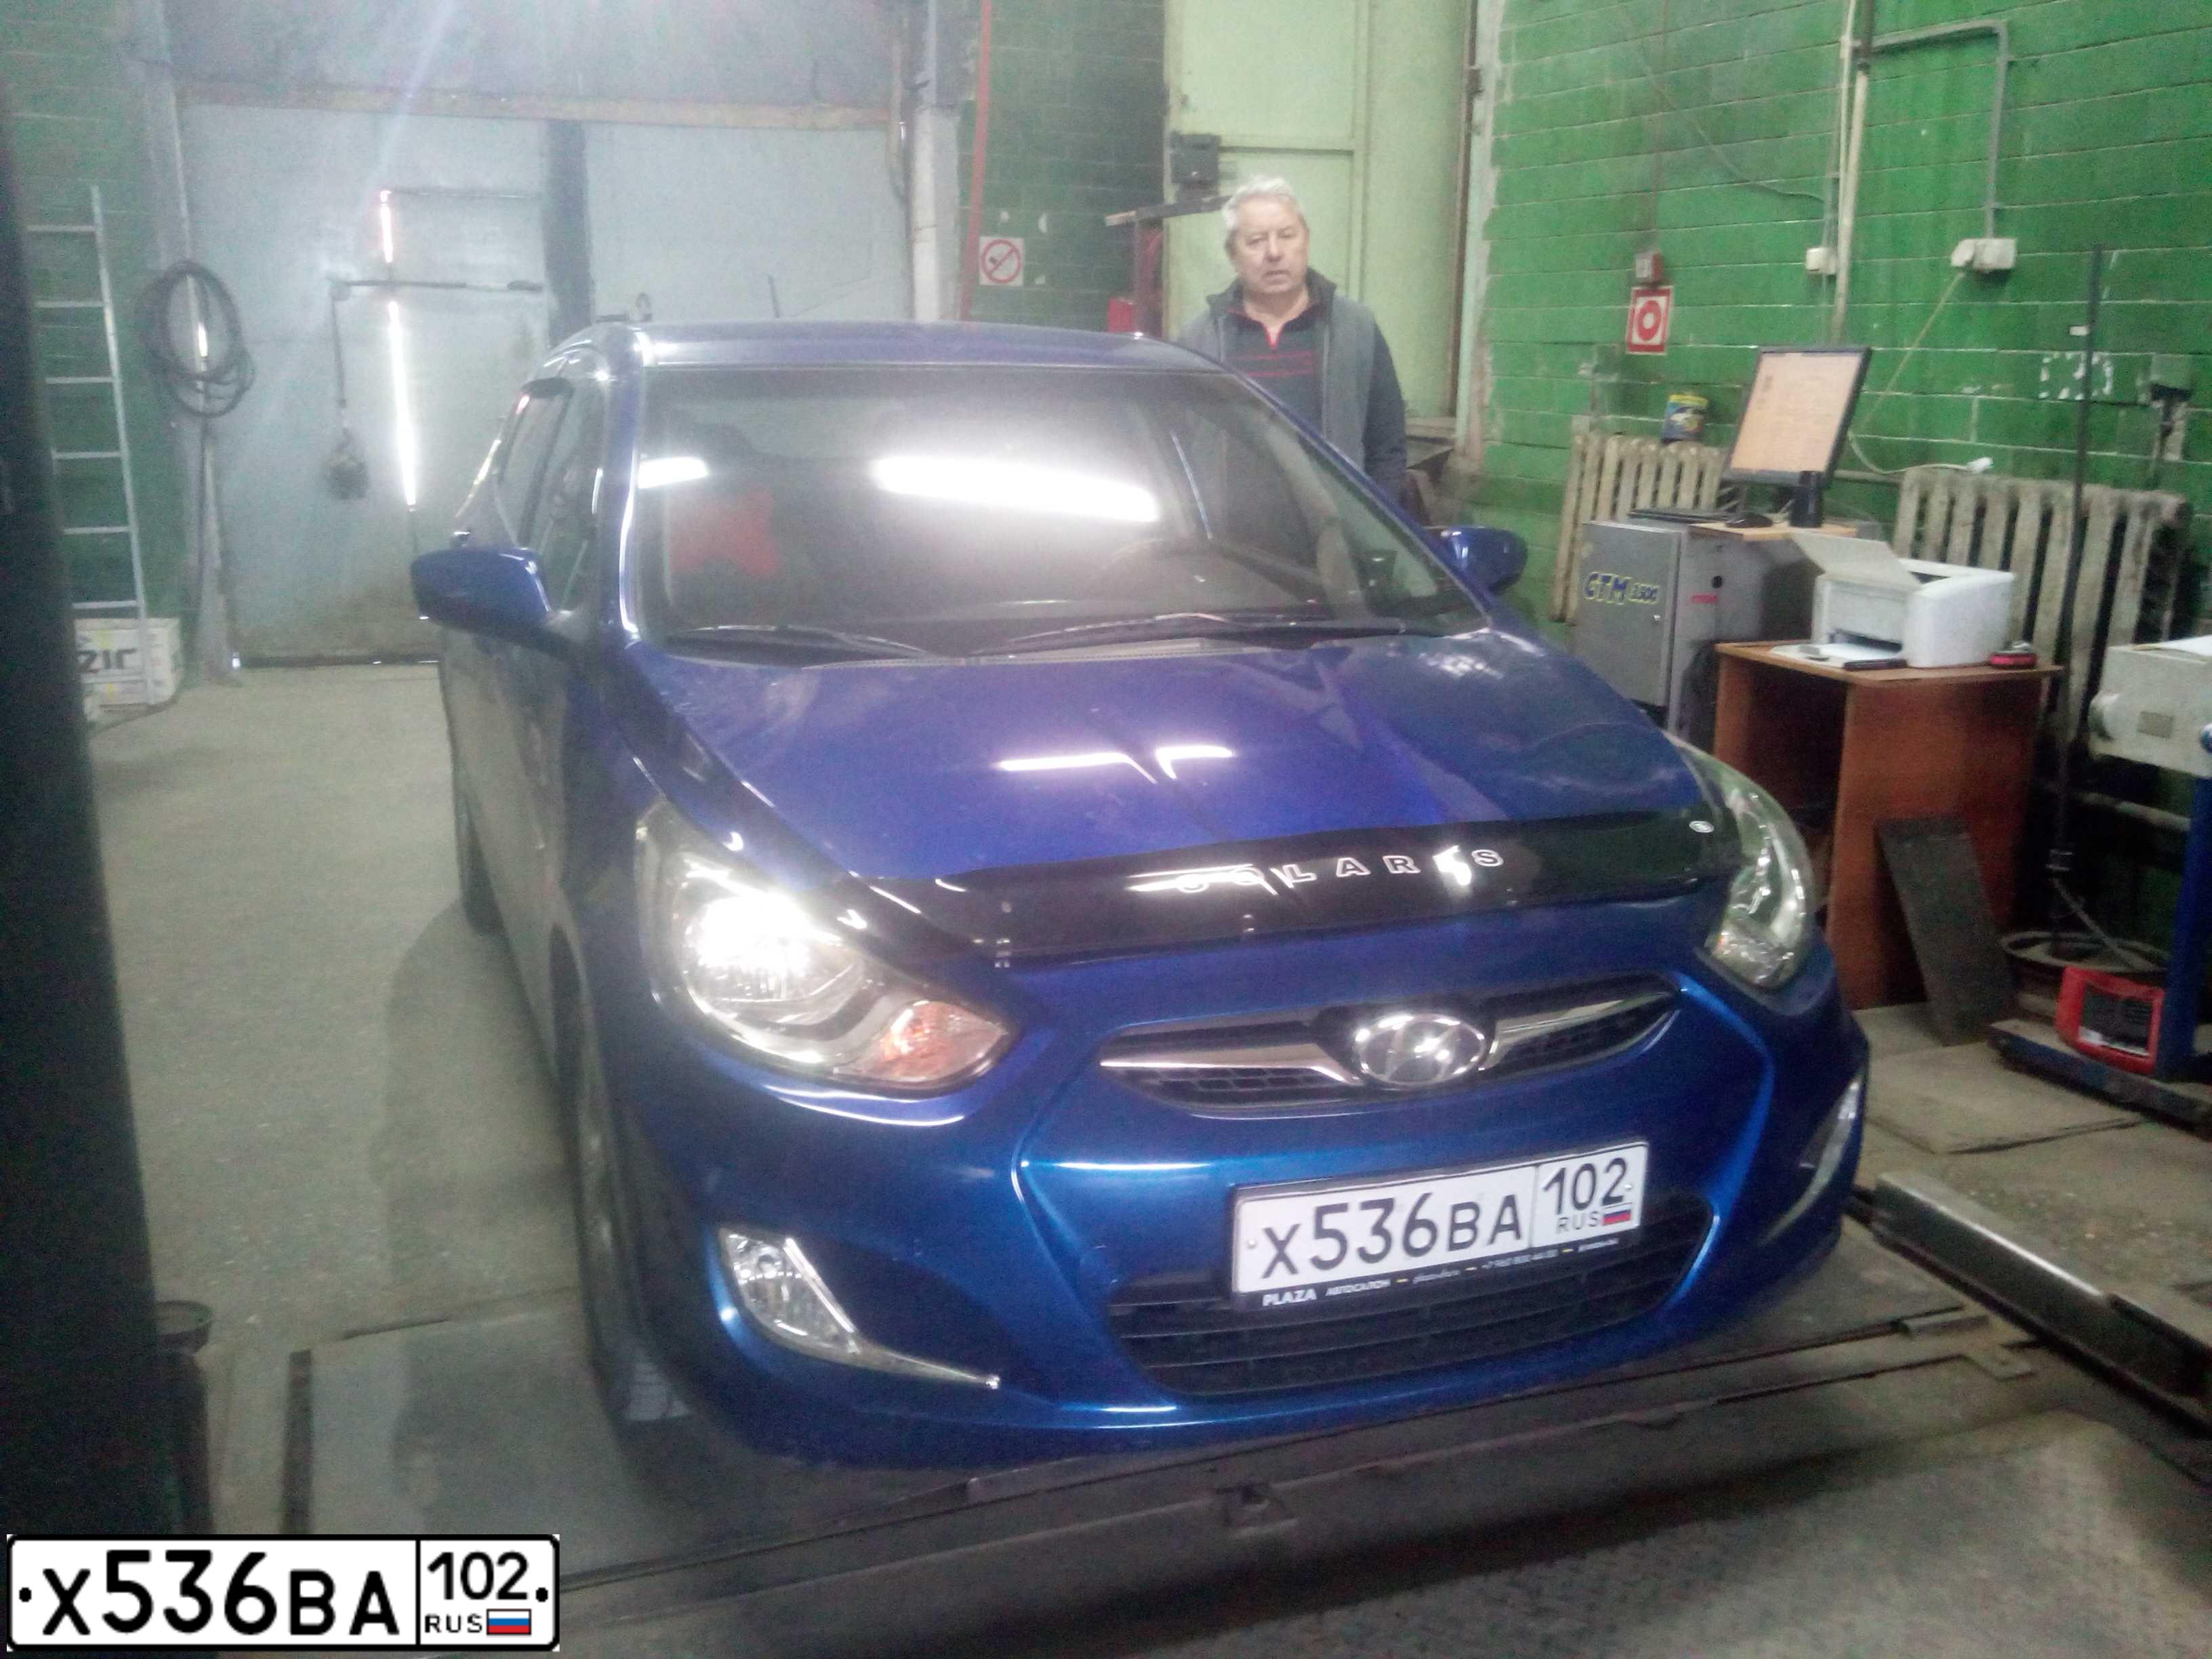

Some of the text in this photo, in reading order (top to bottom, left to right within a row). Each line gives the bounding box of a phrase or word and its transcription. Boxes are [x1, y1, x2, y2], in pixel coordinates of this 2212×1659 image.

[1543, 1157, 1628, 1215] 102
[1556, 1210, 1598, 1234] RUS
[1263, 1288, 1317, 1307] PLAZA
